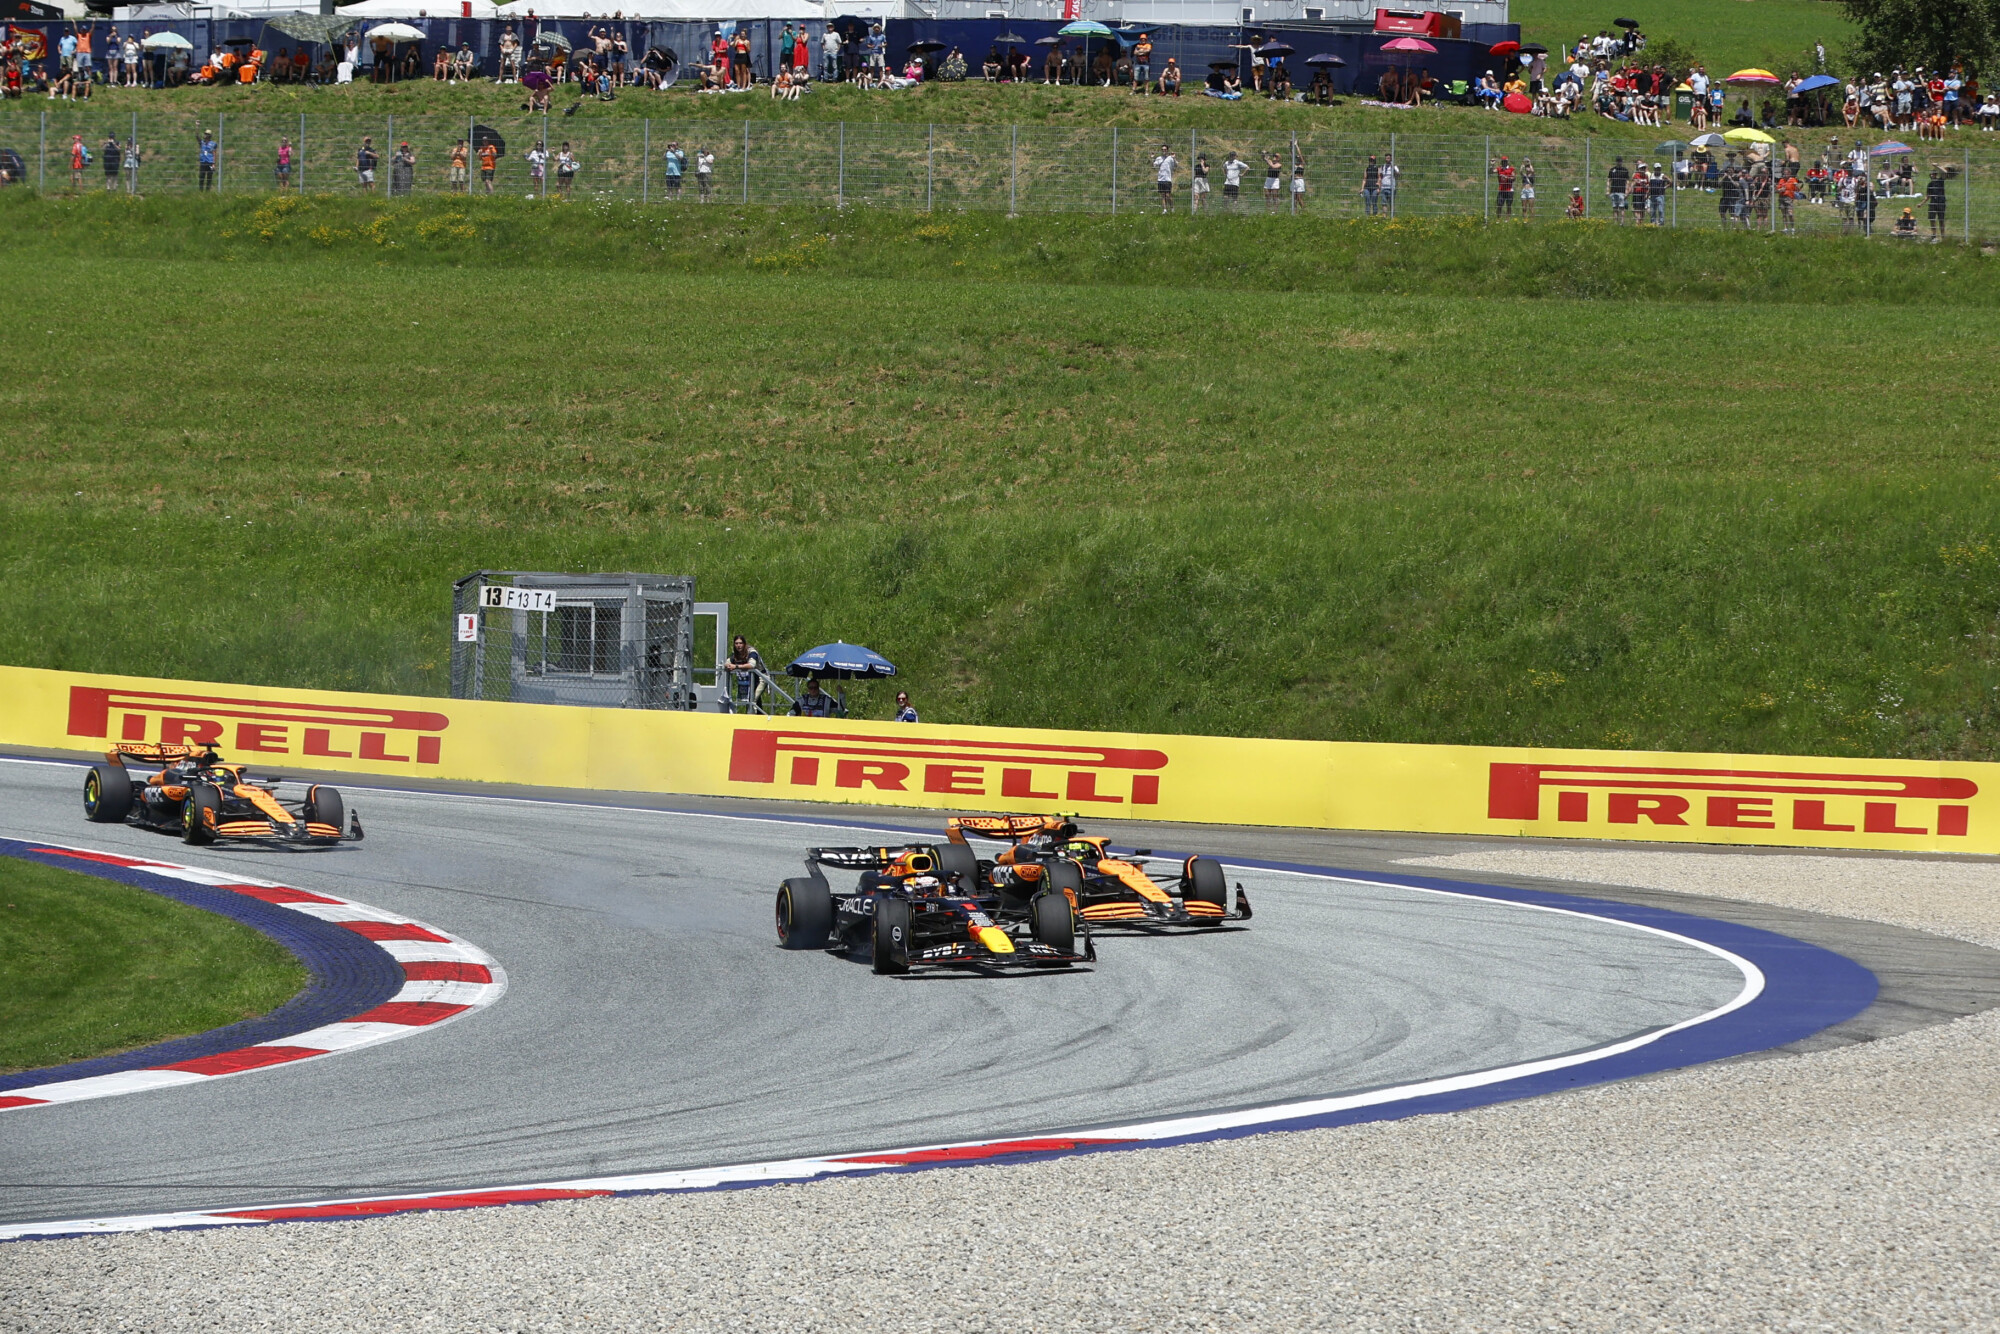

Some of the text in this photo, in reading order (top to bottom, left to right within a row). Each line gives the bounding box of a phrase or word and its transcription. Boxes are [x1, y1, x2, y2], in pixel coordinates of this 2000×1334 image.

[485, 587, 502, 606] 13
[507, 590, 530, 608] F 13
[534, 593, 552, 609] T 4
[67, 685, 449, 765] PIRELLI
[728, 728, 1169, 805] PIRELLI
[1488, 762, 1978, 836] PIRELLI
[922, 942, 965, 959] BYBIT
